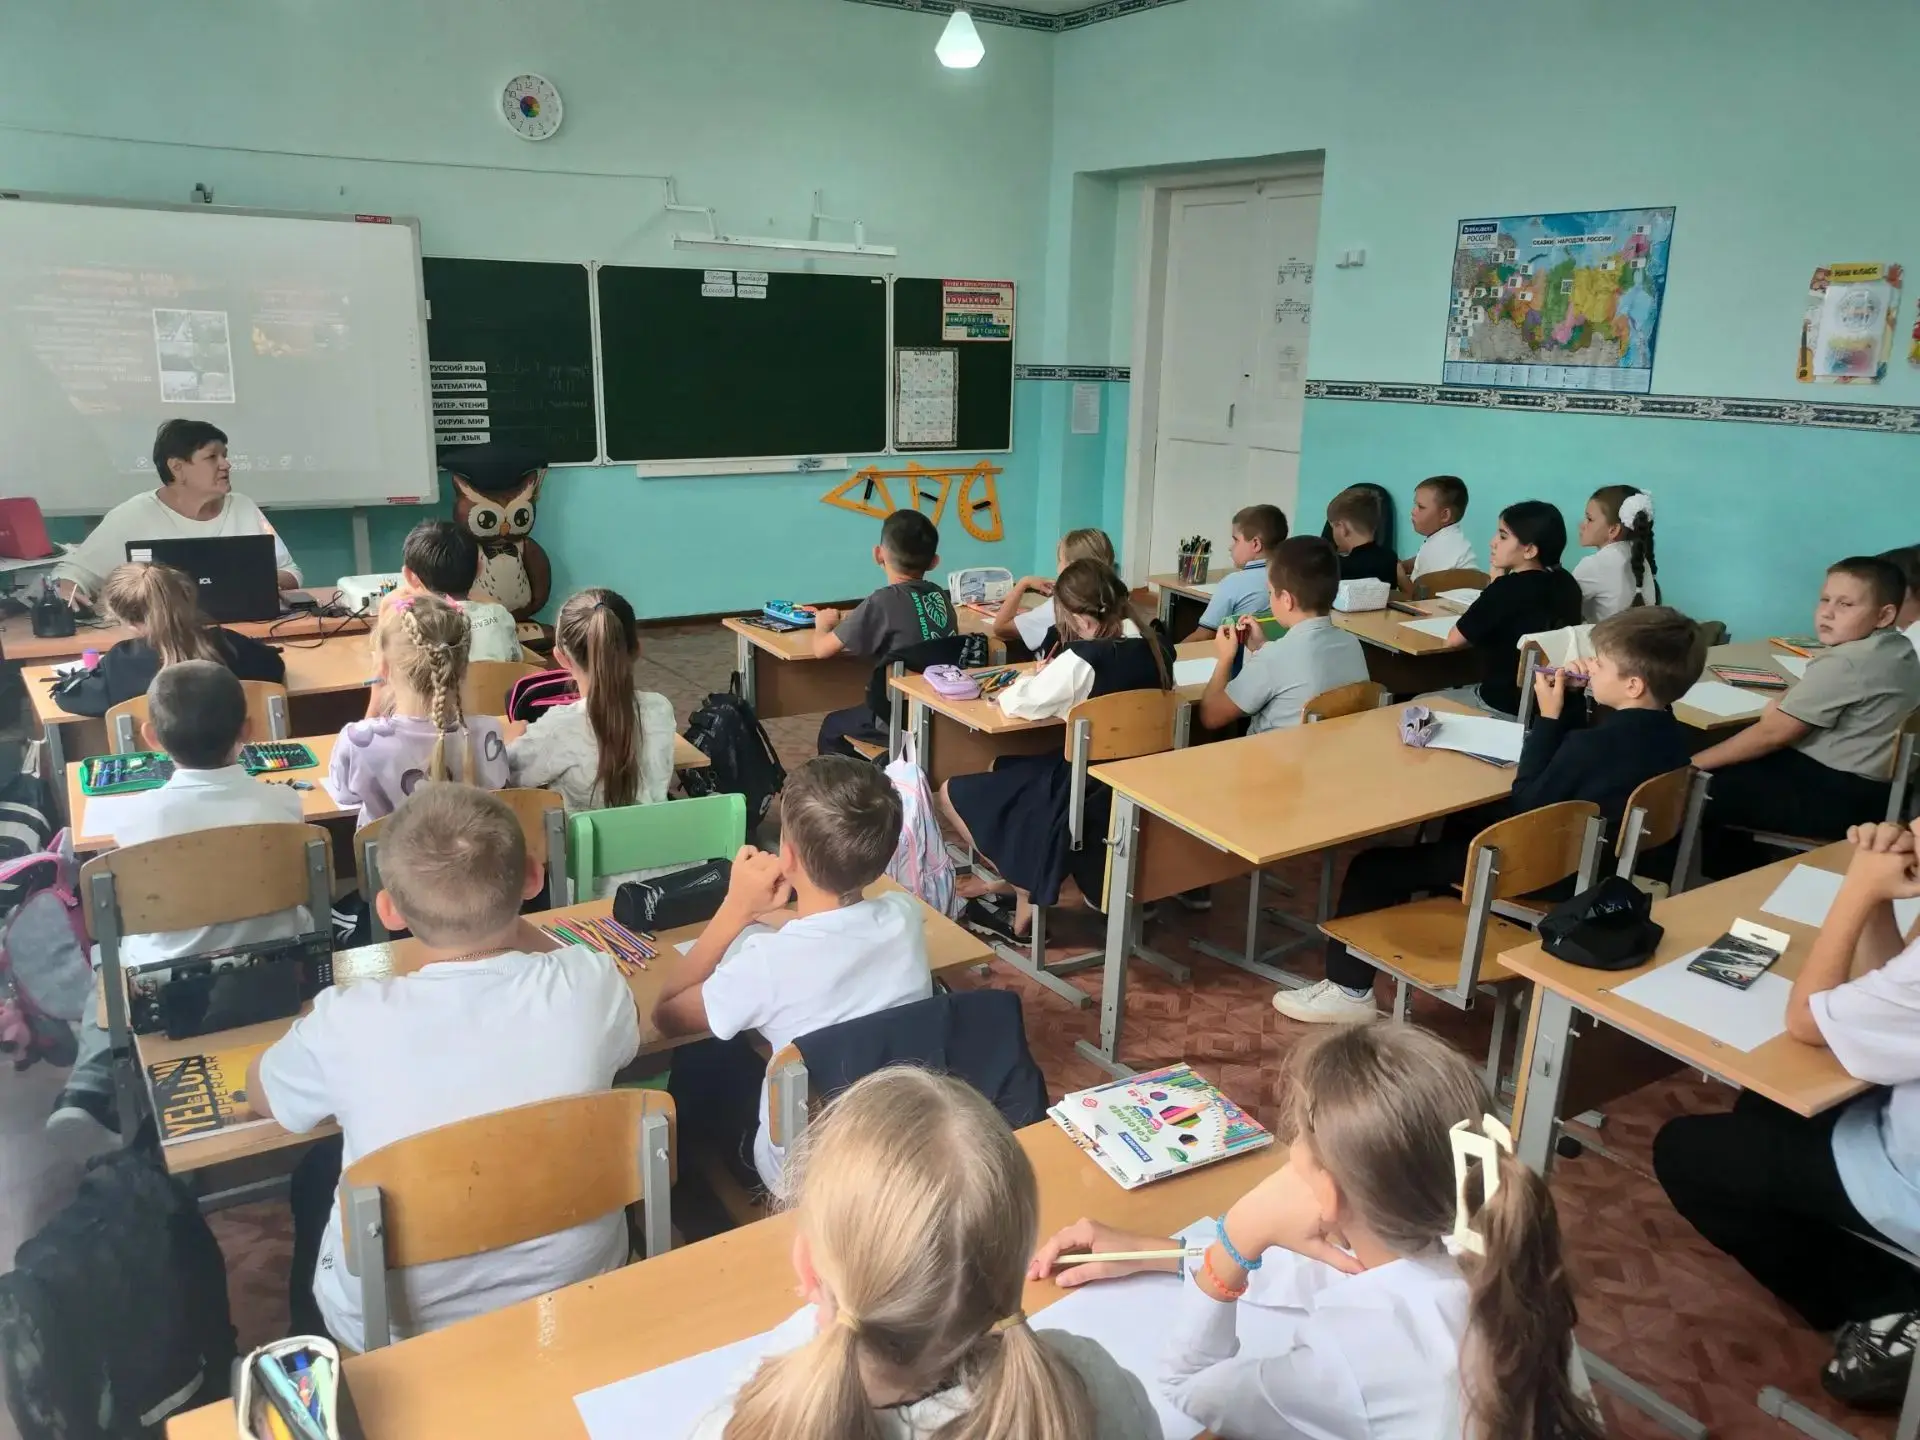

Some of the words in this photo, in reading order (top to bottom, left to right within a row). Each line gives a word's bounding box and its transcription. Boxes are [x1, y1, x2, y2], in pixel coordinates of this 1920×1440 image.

[1466, 234, 1492, 242] РОССИЯ
[1557, 237, 1584, 245] НАРОДОВ
[1586, 235, 1611, 243] РОССИИ
[430, 364, 463, 373] РУССКИЙ
[432, 382, 483, 390] МАТЕМАТИКА
[438, 418, 466, 426] ОКРУЖ.
[920, 616, 930, 641] YOUR
